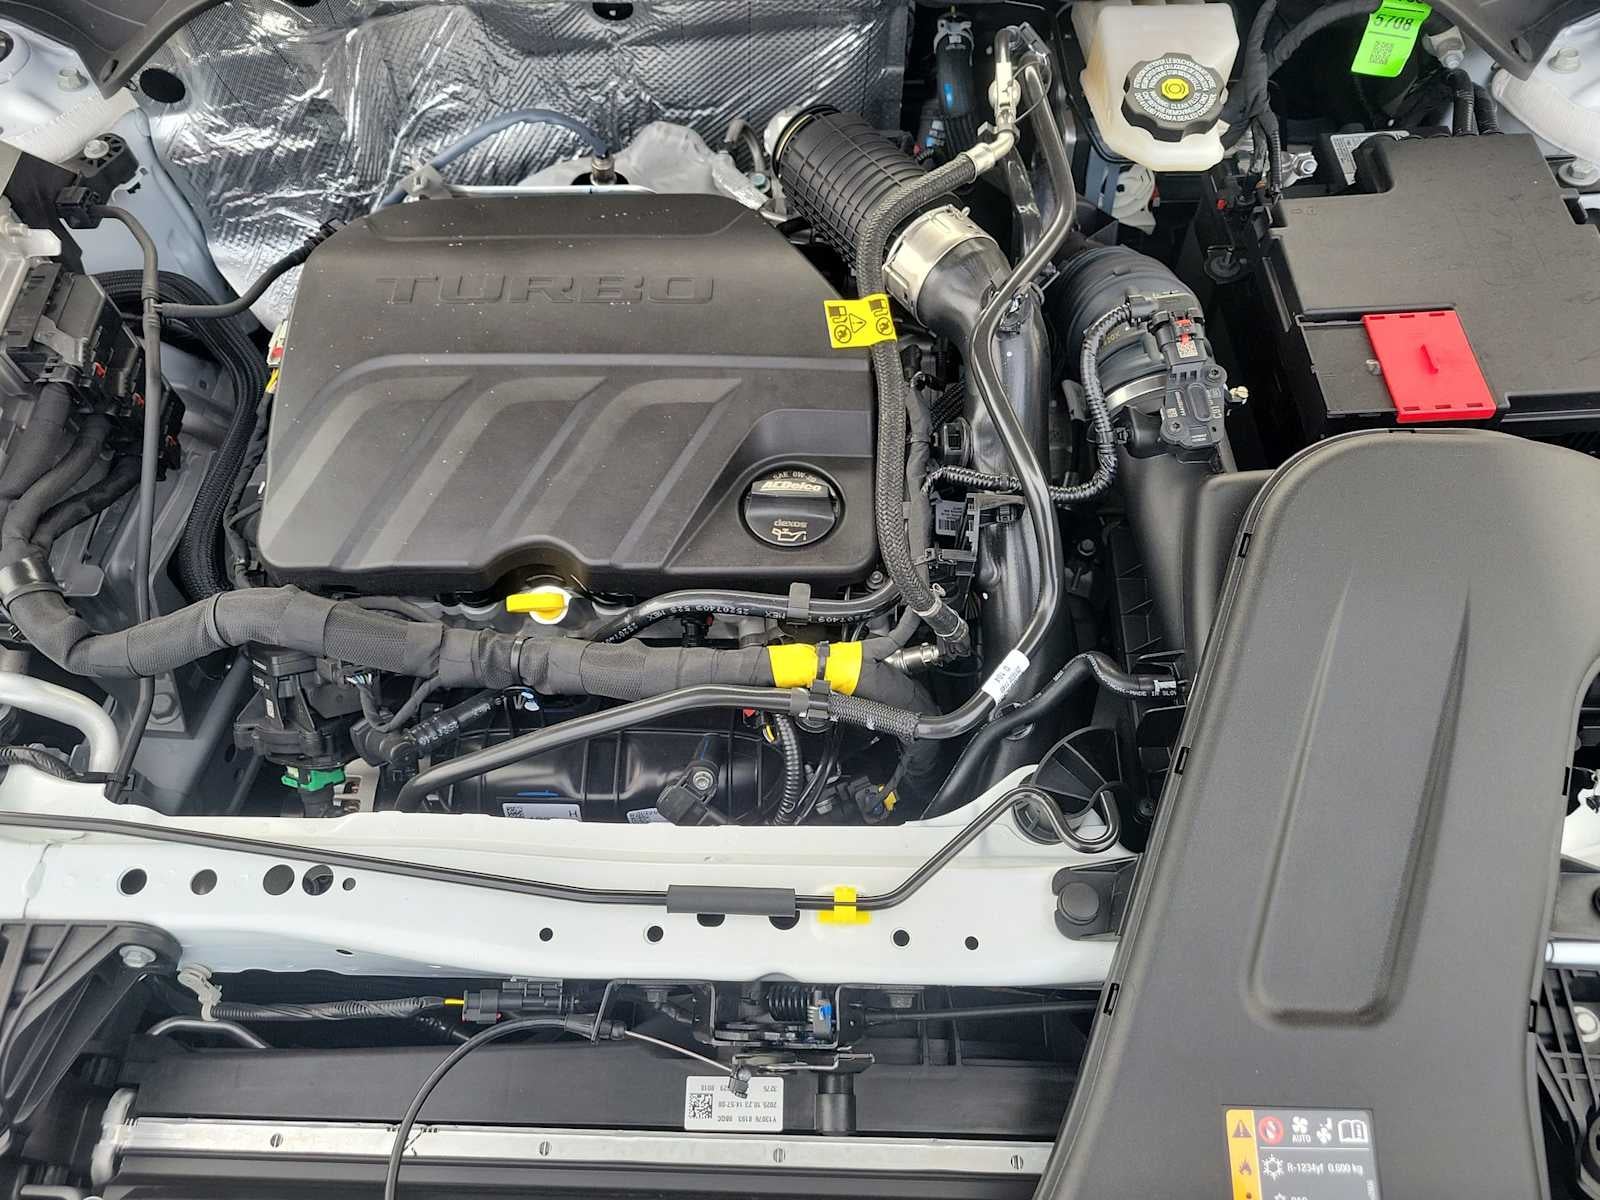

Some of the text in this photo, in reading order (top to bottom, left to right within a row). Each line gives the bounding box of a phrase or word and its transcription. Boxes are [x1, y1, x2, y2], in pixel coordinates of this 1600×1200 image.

[376, 274, 714, 304] TURBO
[760, 481, 822, 491] ACDelco
[774, 519, 808, 528] dexos
[1292, 1134, 1312, 1143] AUTO
